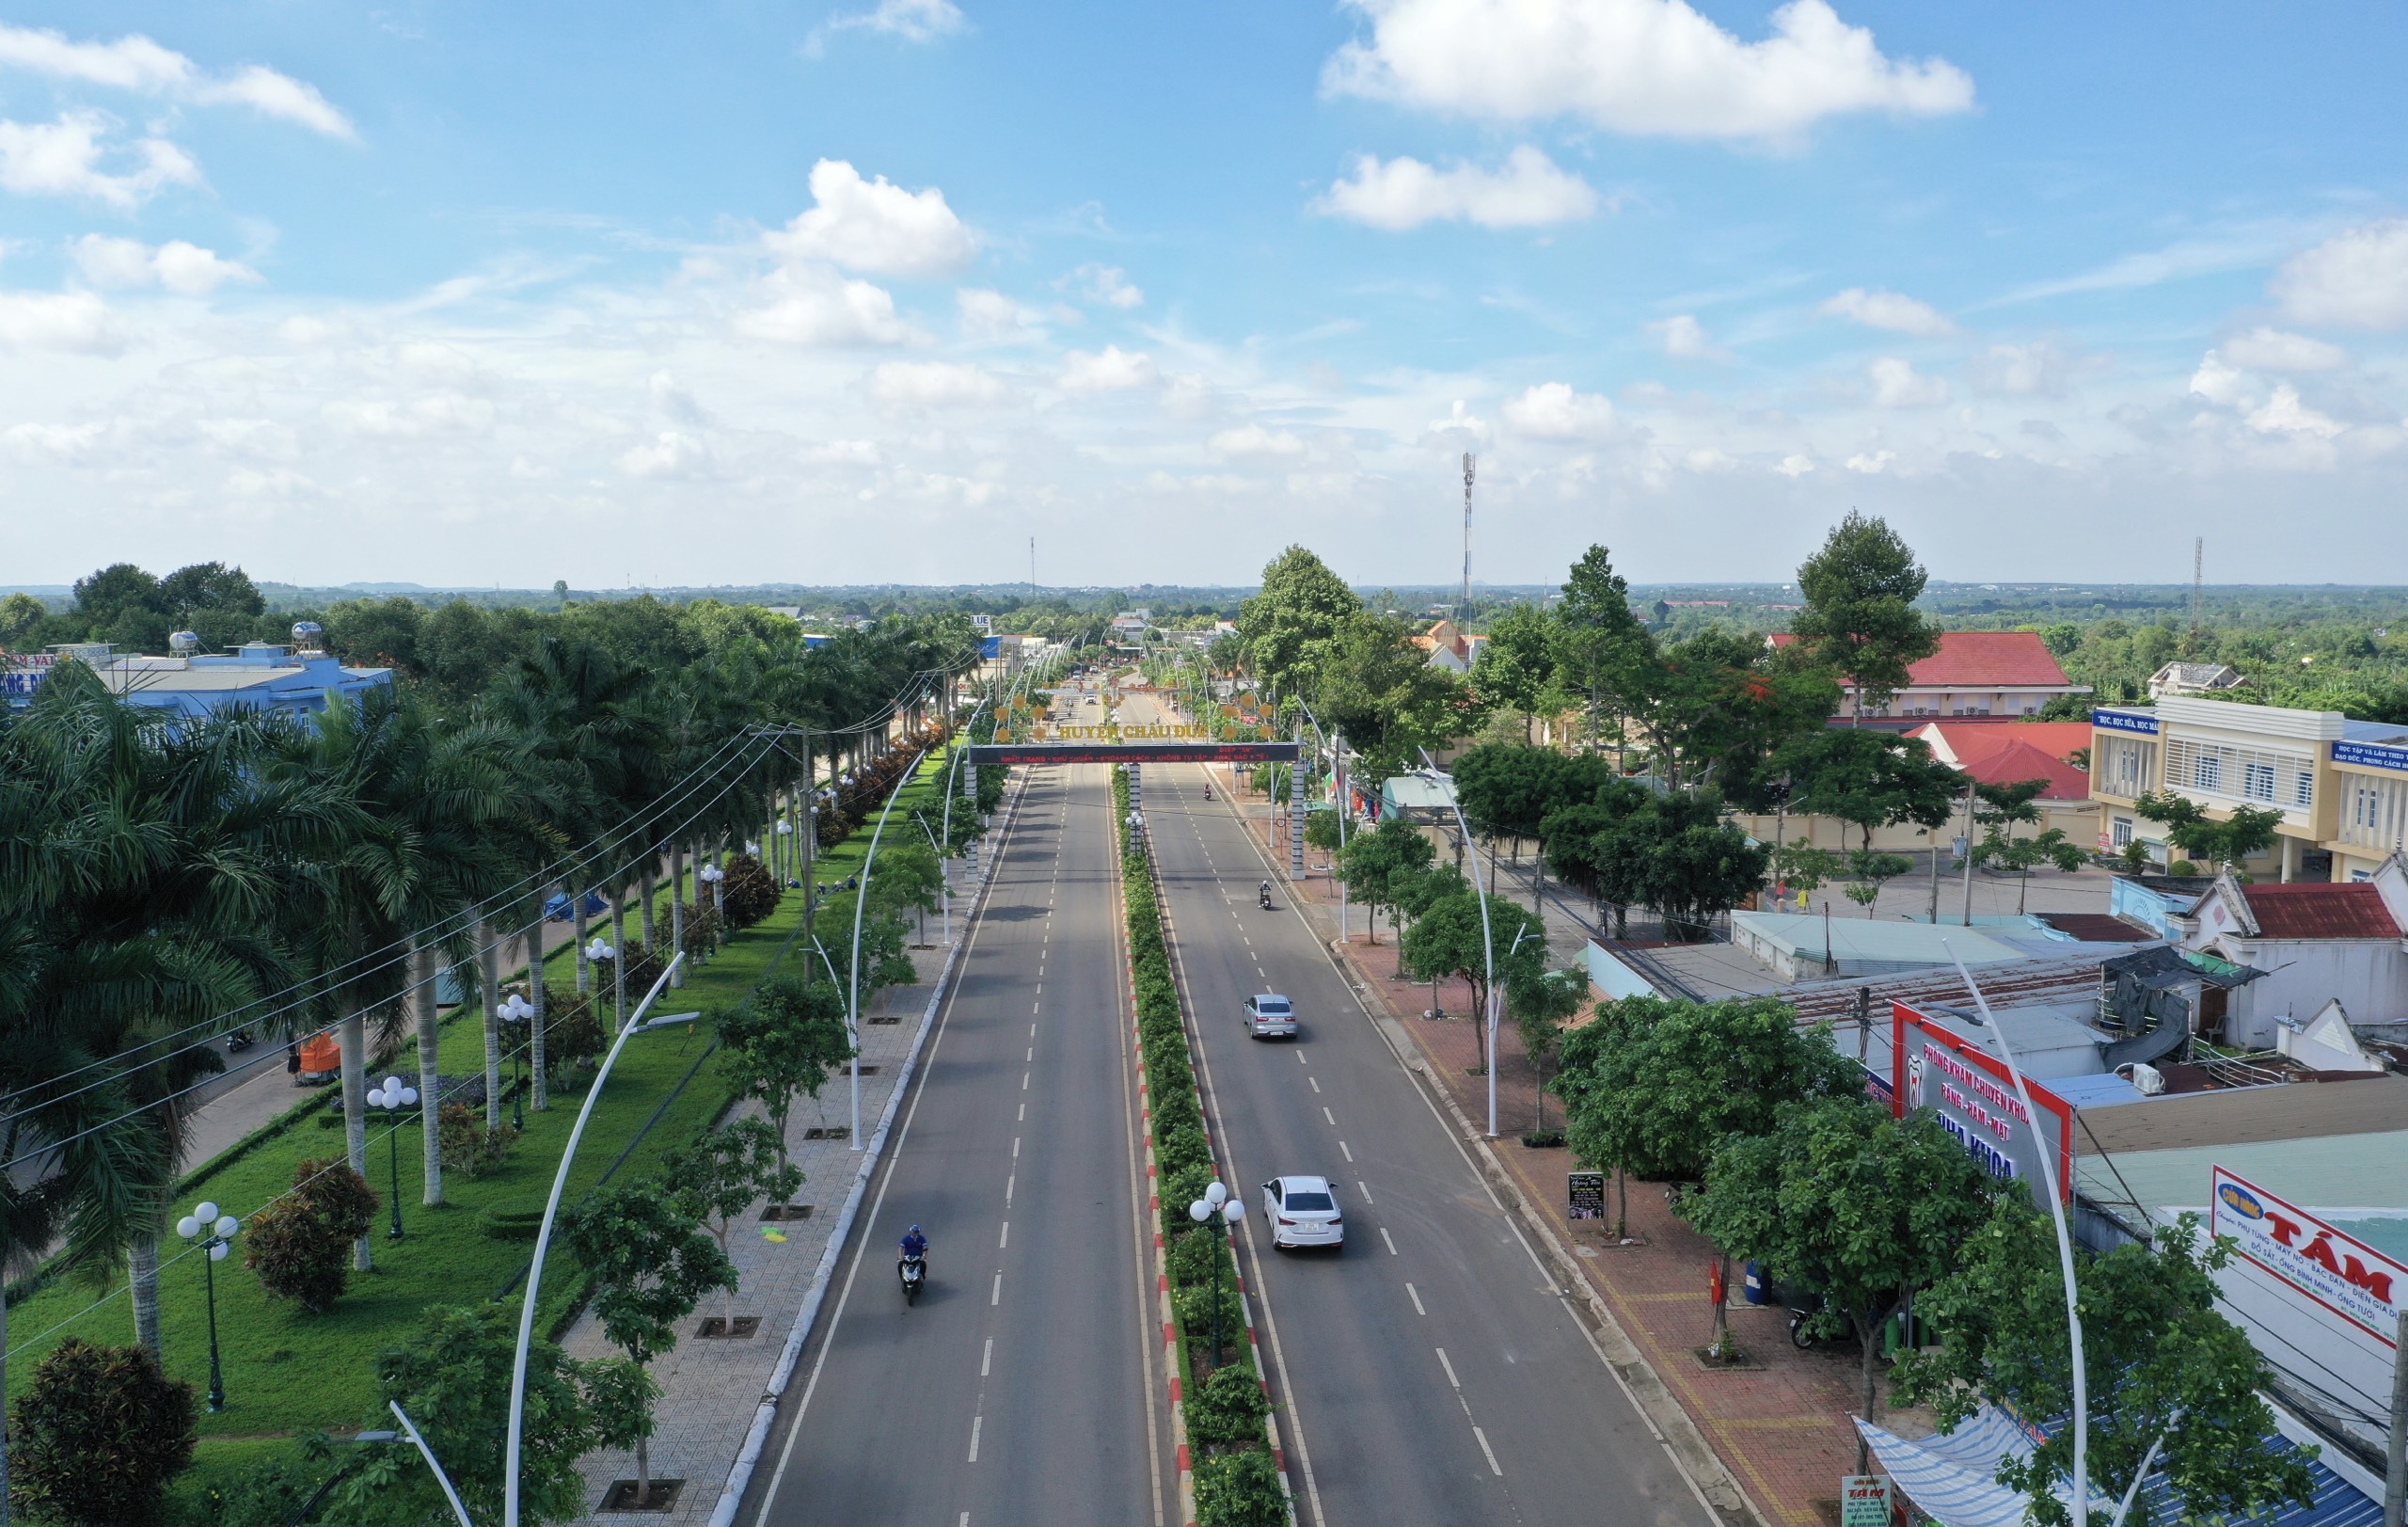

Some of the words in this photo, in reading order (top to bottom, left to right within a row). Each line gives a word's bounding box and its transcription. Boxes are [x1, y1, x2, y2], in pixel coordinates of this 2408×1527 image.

[1123, 723, 1170, 738] CHÂU
[2264, 1211, 2394, 1304] TÁM
[2314, 1279, 2333, 1296] MINH
[2372, 1299, 2387, 1314] GIA
